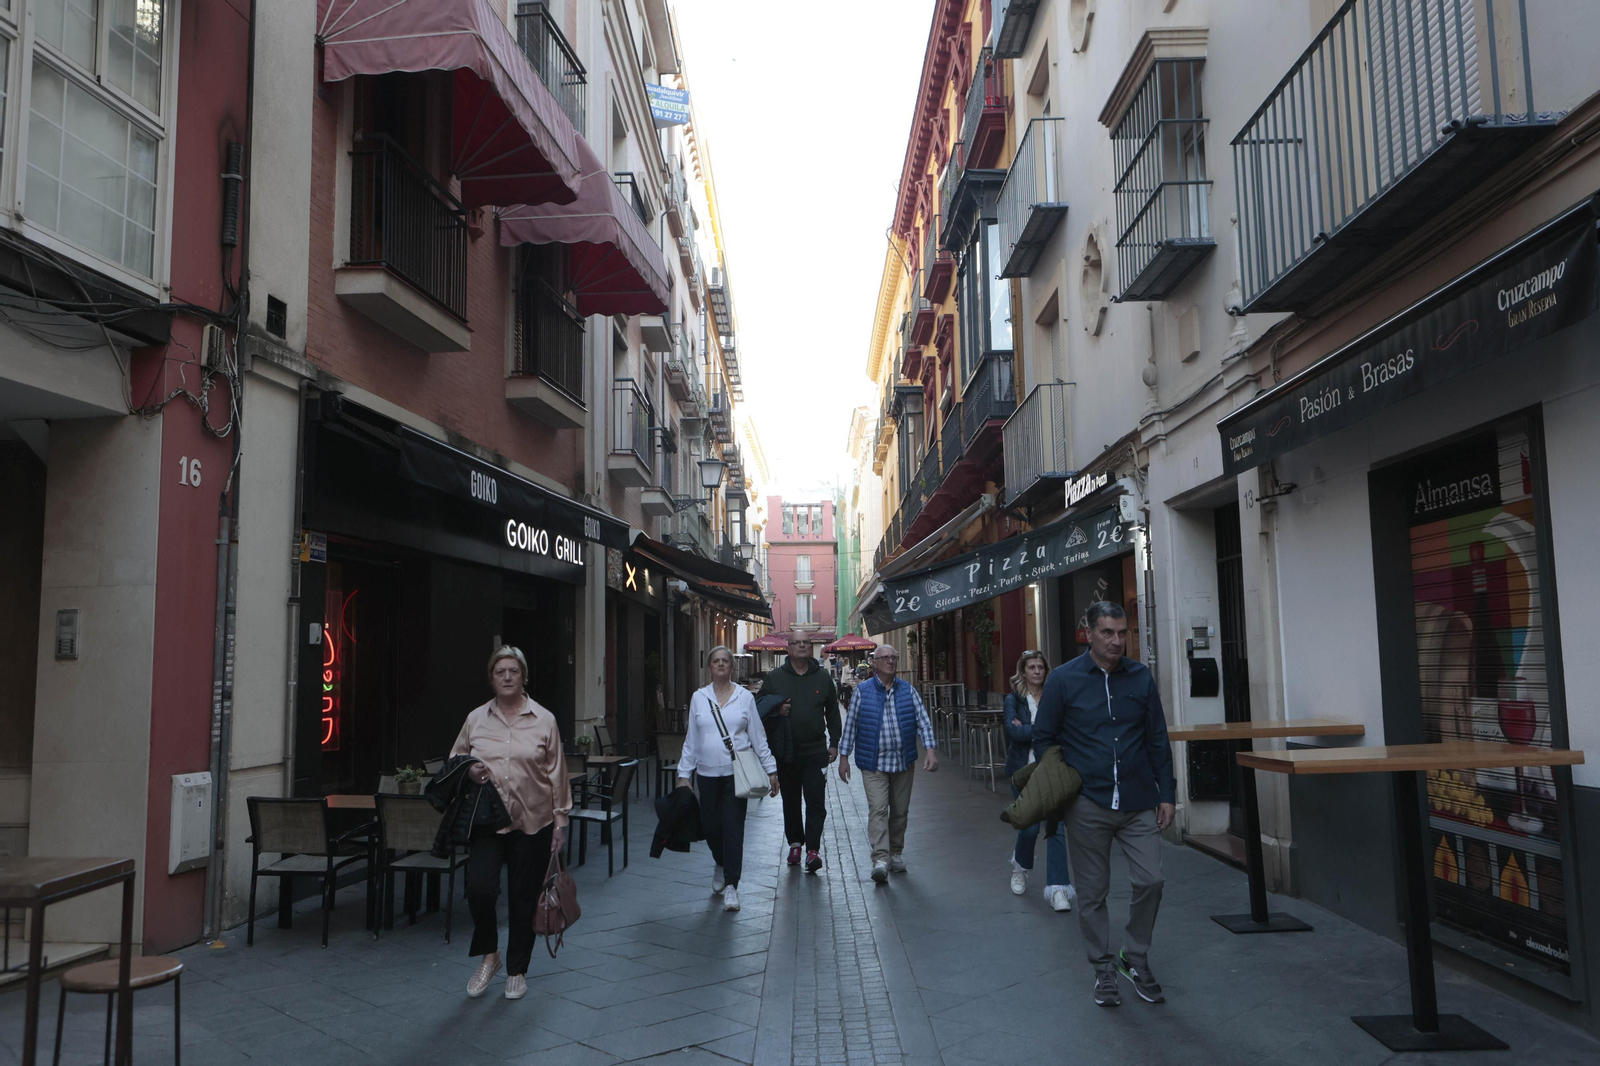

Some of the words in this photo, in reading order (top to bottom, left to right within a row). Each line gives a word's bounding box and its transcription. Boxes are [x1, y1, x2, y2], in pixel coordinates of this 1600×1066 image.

[655, 100, 686, 112] ALQUILA
[655, 109, 663, 117] 91
[664, 111, 672, 119] 27
[1497, 260, 1566, 311] Cruzcampo
[1299, 386, 1341, 423] Pasión
[1348, 386, 1355, 400] &
[1360, 348, 1415, 393] Brasas
[1229, 428, 1256, 451] Cruzcampo
[178, 456, 202, 487] 16
[470, 470, 498, 505] GOIKO
[1064, 473, 1091, 509] Piazza
[1096, 471, 1108, 490] Pezzi
[1244, 489, 1254, 509] 13
[1414, 473, 1494, 513] Almansa
[584, 515, 601, 541] GOIKO
[1096, 519, 1111, 531] from
[1097, 525, 1123, 549] 2€
[506, 518, 549, 556] GOIKO
[555, 535, 584, 566] GRILL
[934, 595, 960, 609] Slices
[968, 583, 990, 598] Pezzi
[998, 574, 1022, 588] Parts
[1031, 562, 1056, 577] Stück
[1063, 550, 1090, 565] Fatias
[964, 545, 1046, 583] Pizza
[894, 595, 921, 614] 2€
[895, 588, 910, 596] from
[1077, 577, 1109, 630] Piza
